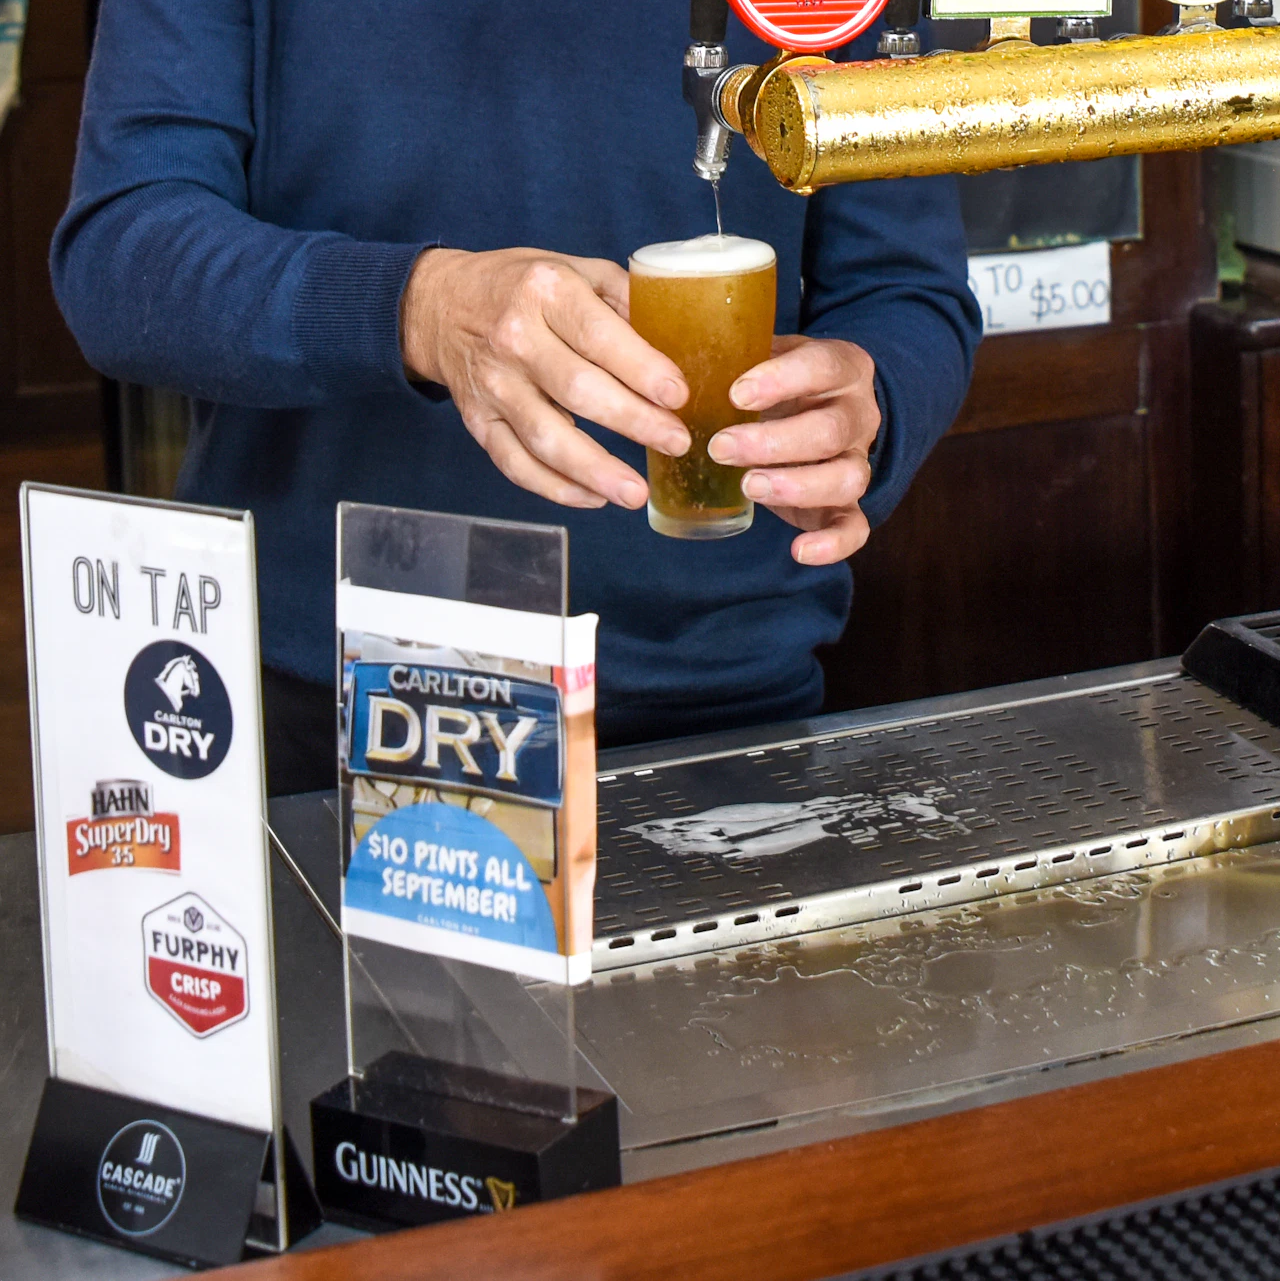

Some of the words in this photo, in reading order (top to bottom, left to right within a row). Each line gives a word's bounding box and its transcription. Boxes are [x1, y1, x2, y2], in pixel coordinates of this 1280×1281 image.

[984, 263, 1023, 296] TO
[1030, 277, 1110, 324] $5.00
[72, 556, 120, 620] ON
[140, 565, 221, 635] TAP
[388, 664, 512, 707] CARLTON
[144, 721, 214, 760] DRY
[154, 710, 202, 730] CARLTON
[365, 693, 537, 783] DRY
[91, 788, 150, 817] HAHN
[75, 817, 170, 858] SuperDry
[368, 829, 408, 865] $10
[414, 839, 479, 880] PINTS
[484, 855, 532, 891] ALL
[381, 866, 517, 923] SEPTEMBER!
[151, 930, 239, 971] FURPHY
[171, 971, 222, 1001] CRISP
[102, 1160, 175, 1198] CASCADE
[335, 1140, 483, 1212] GUINNESS
